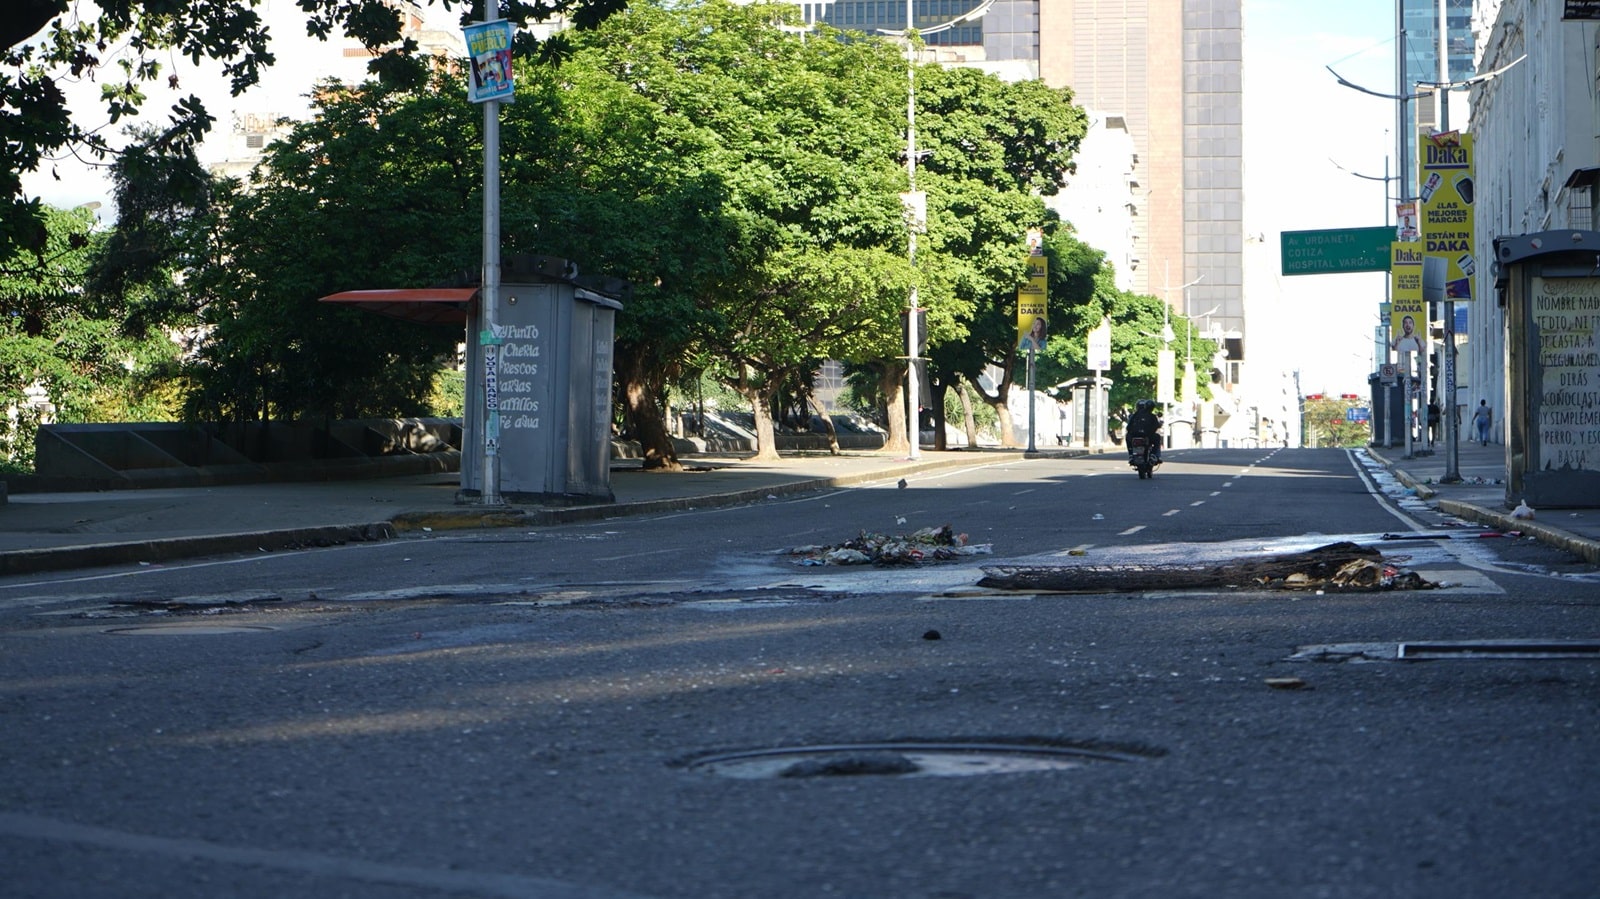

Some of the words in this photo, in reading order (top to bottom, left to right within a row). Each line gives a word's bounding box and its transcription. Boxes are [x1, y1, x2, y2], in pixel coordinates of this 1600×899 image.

[1427, 144, 1467, 164] Daka
[1427, 209, 1467, 217] MEJORES
[1428, 216, 1467, 224] MARCAS?
[1304, 234, 1356, 245] URDANETA
[1426, 231, 1455, 240] ESTÁN
[1288, 248, 1324, 257] COTIZA
[1426, 240, 1470, 252] DAKA
[1395, 249, 1422, 262] Daka
[1288, 259, 1335, 270] HOSPITAL
[1338, 257, 1376, 267] VARGAS
[1394, 305, 1423, 313] DAKA
[1537, 295, 1576, 311] NOMBRE
[1575, 315, 1587, 329] NI
[486, 356, 496, 376] VOTA
[1560, 369, 1588, 386] DIRÁS
[487, 378, 497, 408] BLANCO
[1544, 430, 1576, 446] PERRO,
[1580, 430, 1585, 444] Y
